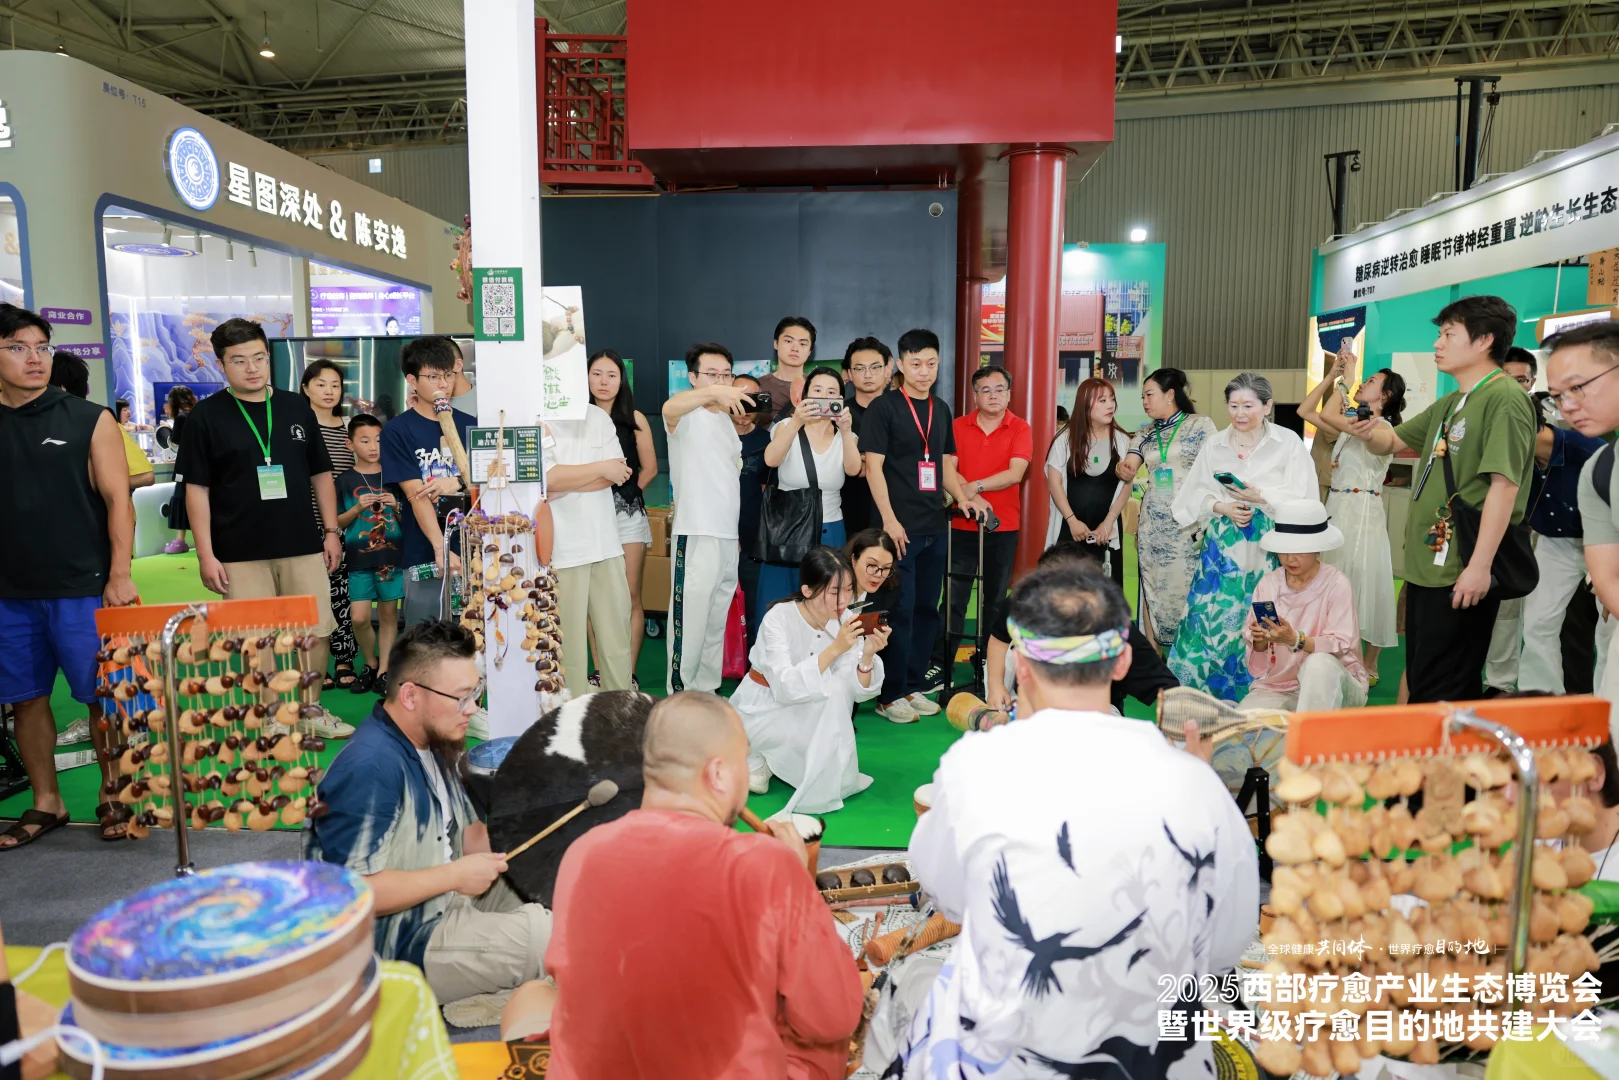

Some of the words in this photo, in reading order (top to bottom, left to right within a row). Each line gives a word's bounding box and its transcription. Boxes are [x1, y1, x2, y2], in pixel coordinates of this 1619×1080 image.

[228, 161, 323, 230] 星图深处
[329, 200, 348, 241] &
[354, 211, 407, 259] 陈安逸
[1355, 248, 1419, 283] 糖尿病逆转治愈
[1420, 217, 1517, 264] 睡眠节律神经重置
[47, 310, 85, 321] 商业合作
